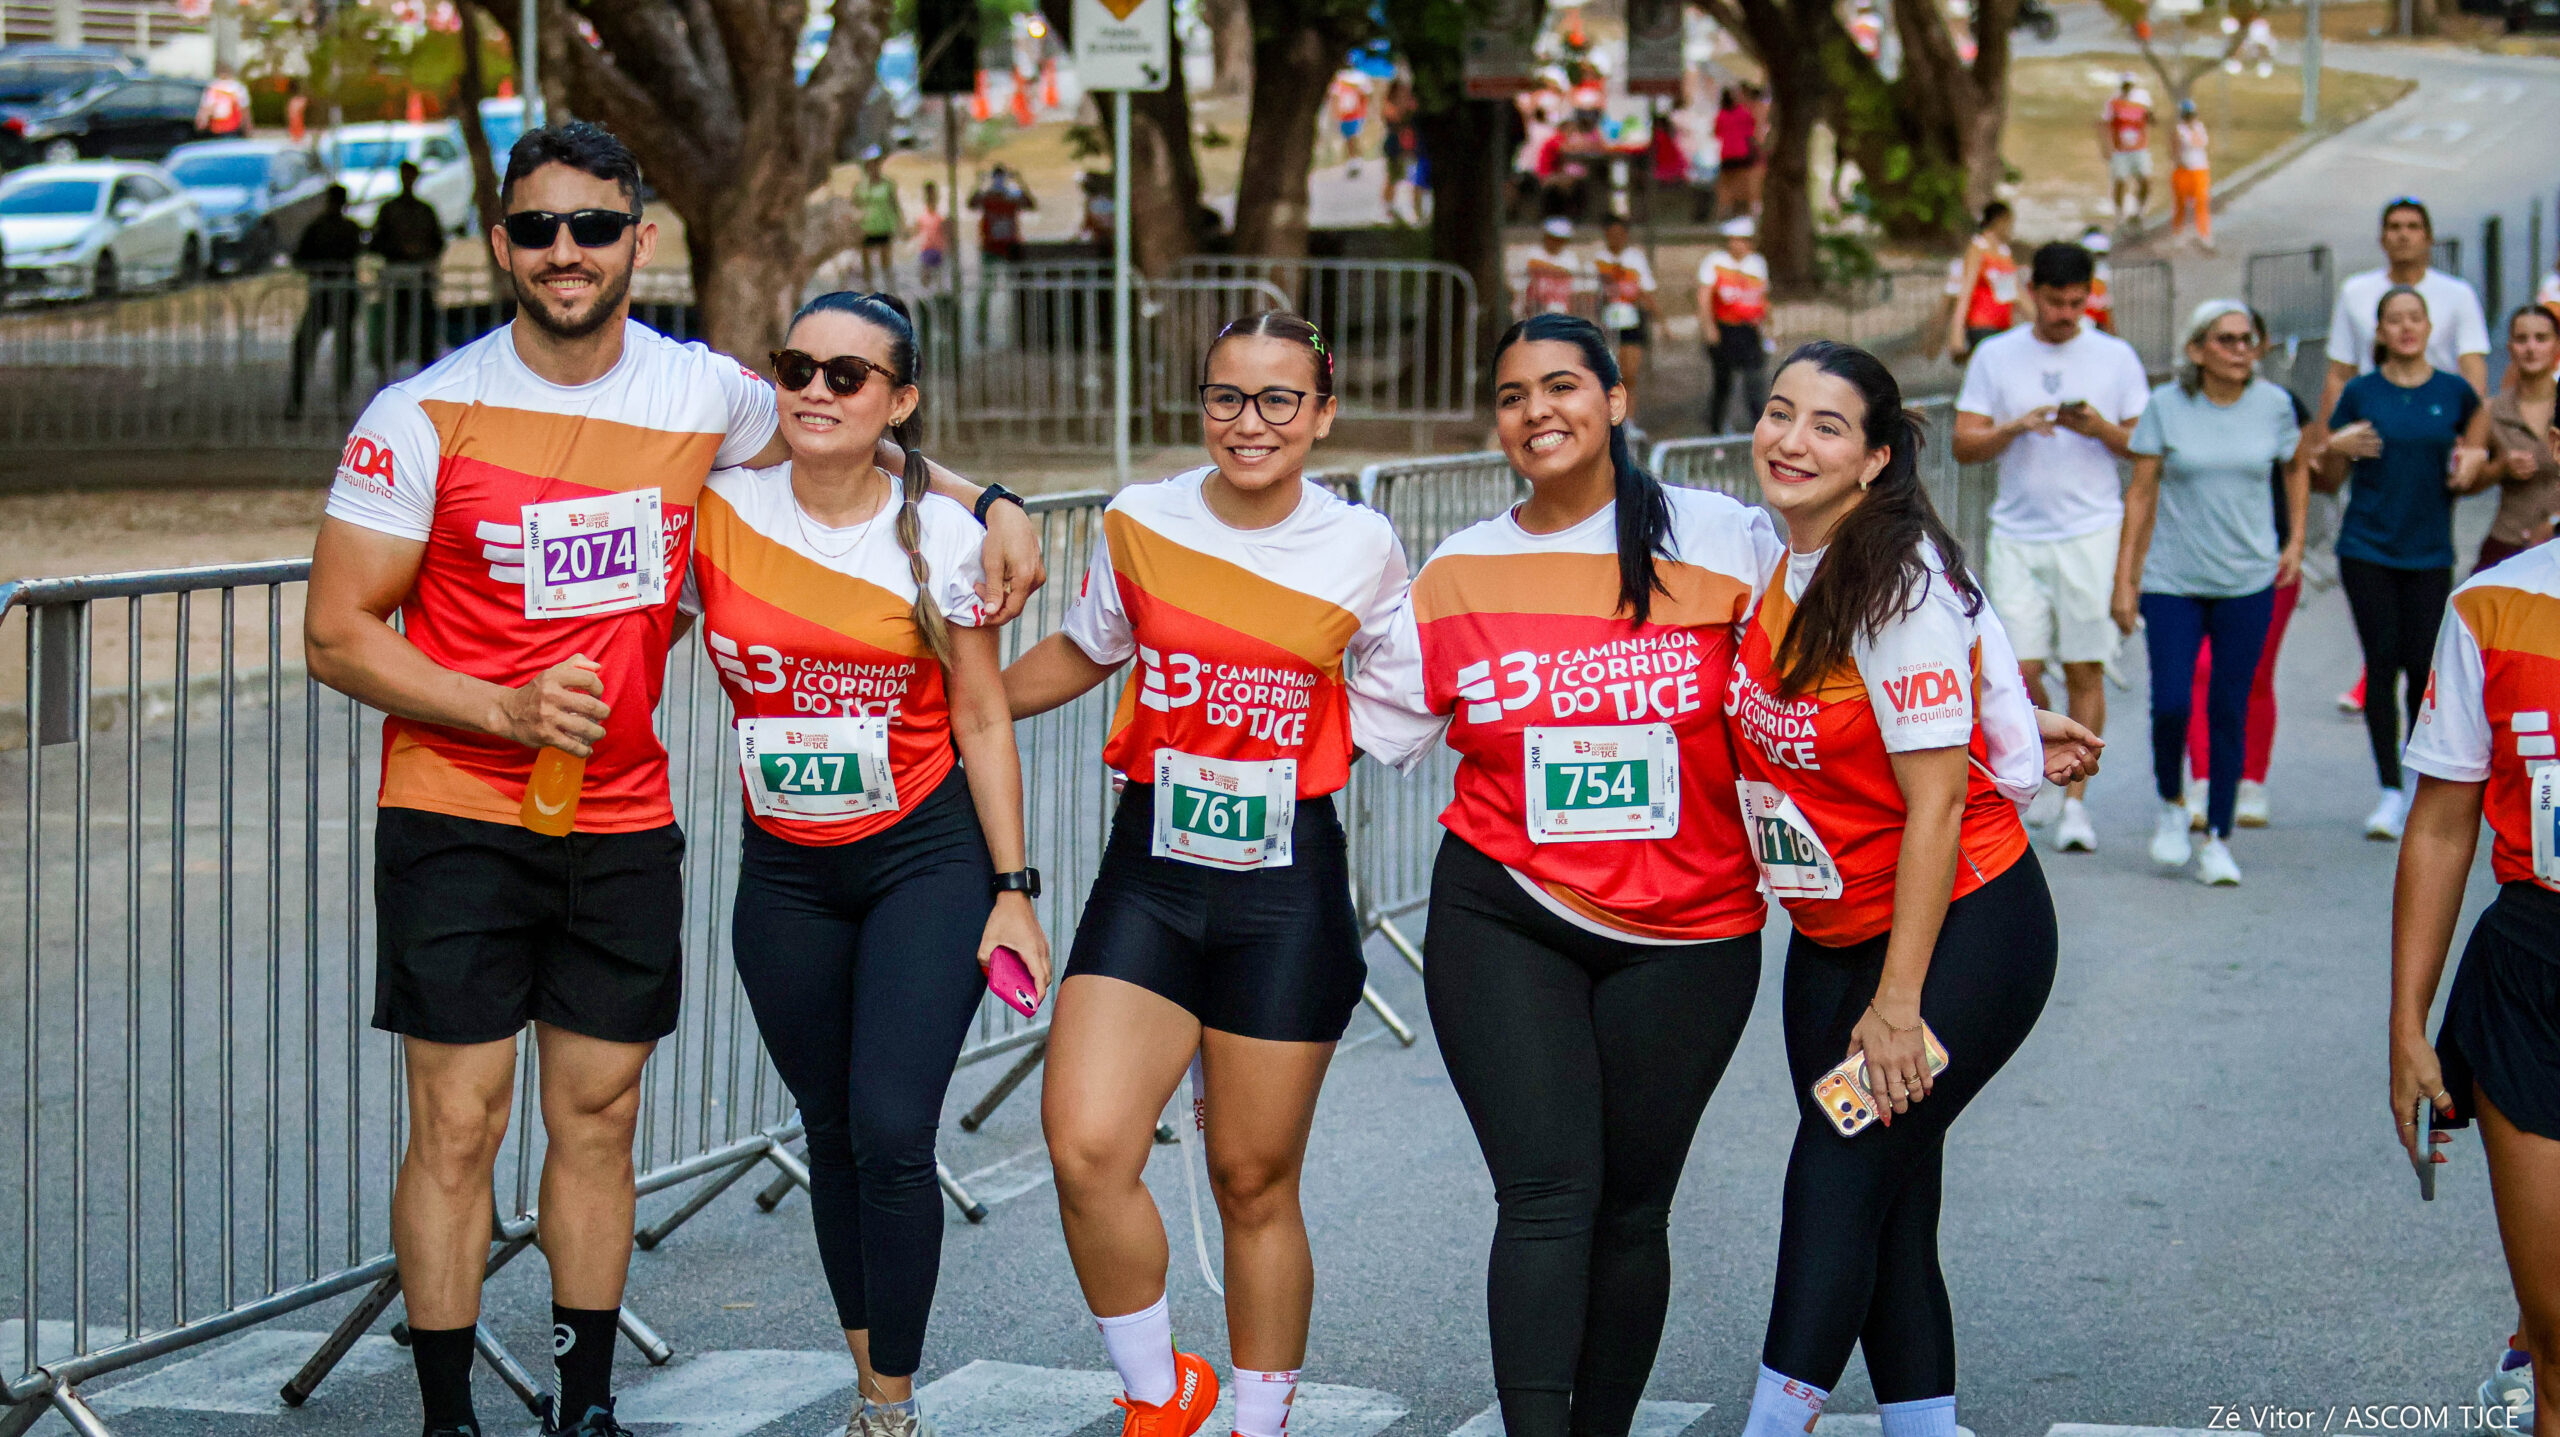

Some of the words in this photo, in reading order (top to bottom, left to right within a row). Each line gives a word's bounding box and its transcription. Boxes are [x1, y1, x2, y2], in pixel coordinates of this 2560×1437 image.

[531, 521, 540, 550] 10KM
[547, 530, 636, 583] 2074
[1557, 632, 1700, 666] CAMINHADA
[800, 657, 917, 678] CAMINHADA
[1216, 664, 1319, 687] CAMINHADA
[1897, 661, 1944, 673] PROGRAMA
[793, 691, 832, 715] DO
[1550, 686, 1601, 719] DO
[1605, 671, 1701, 721] TJCE
[1750, 682, 1820, 717] CAMINHADA
[1882, 668, 1963, 713] VIDA
[1207, 702, 1243, 727] DO
[1246, 707, 1308, 747] TJCE
[1896, 715, 1910, 726] em
[746, 736, 755, 760] 3KM
[1532, 746, 1541, 769] 3KM
[1600, 750, 1617, 758] TJCE
[1757, 731, 1821, 770] TJCE
[775, 756, 846, 792] 247
[1161, 766, 1170, 788] 3KM
[1560, 763, 1636, 806] 754
[1185, 789, 1249, 838] 761
[1744, 798, 1755, 821] 3KM
[2541, 785, 2551, 811] 5KM
[1758, 820, 1814, 863] 1116
[1178, 1367, 1198, 1411] CORRE
